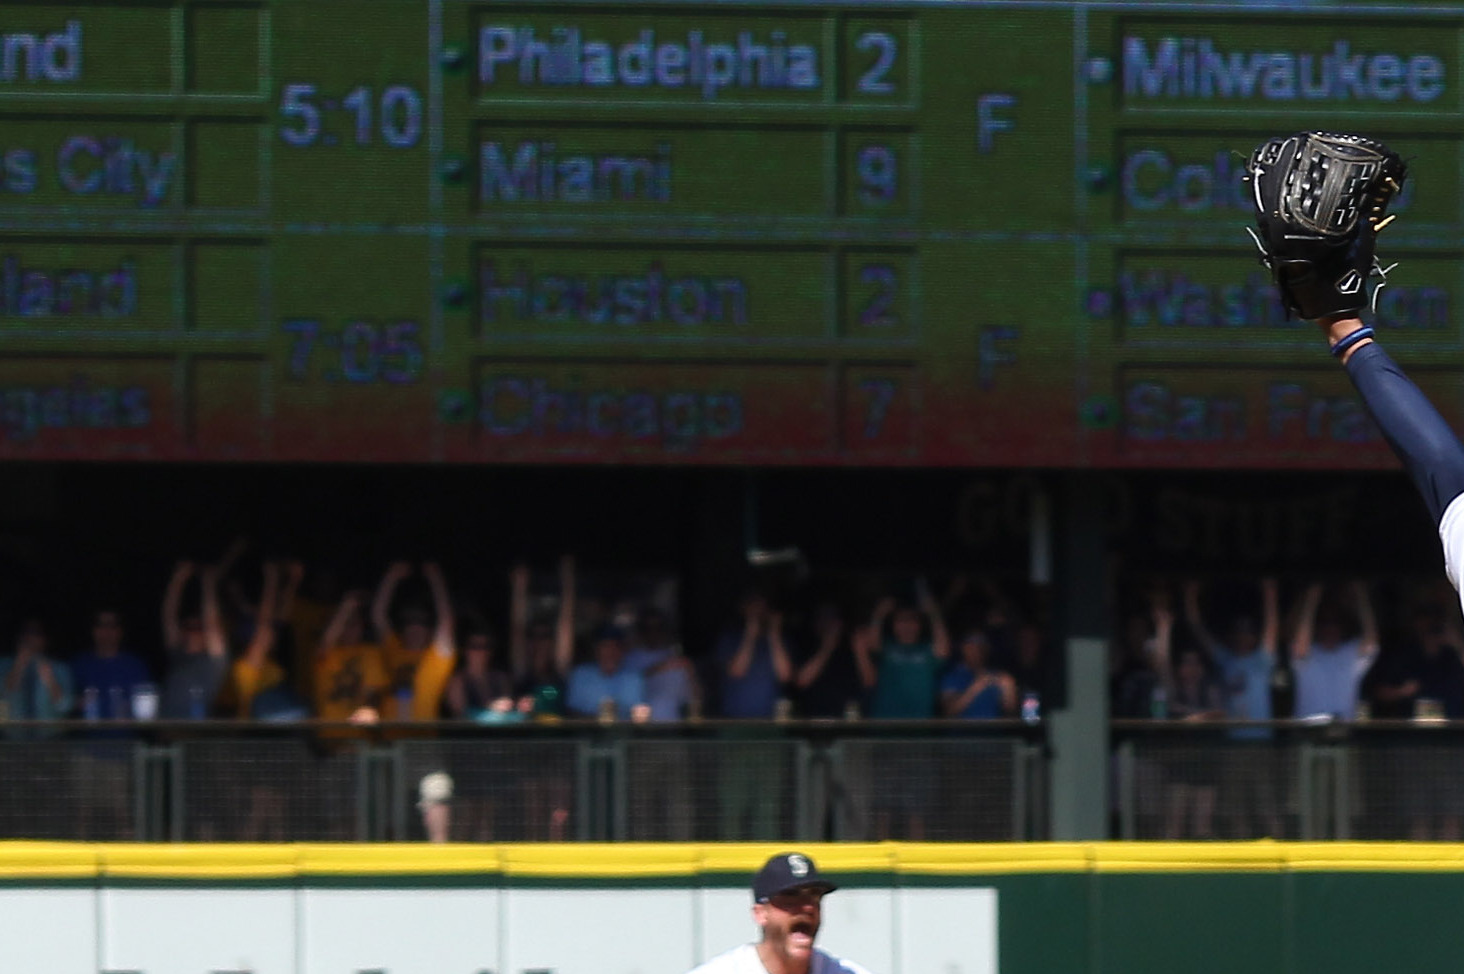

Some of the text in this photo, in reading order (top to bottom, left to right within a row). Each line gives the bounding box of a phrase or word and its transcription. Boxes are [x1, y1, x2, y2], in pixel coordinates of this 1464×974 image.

[0, 18, 82, 81] nd
[479, 24, 898, 99] Philadelphia 2
[1122, 35, 1445, 101] Milwaukee
[279, 81, 423, 147] 5:10
[976, 91, 1018, 154] F
[57, 135, 179, 207] City
[479, 139, 898, 206] Miami 9
[479, 263, 900, 328] Houston 2
